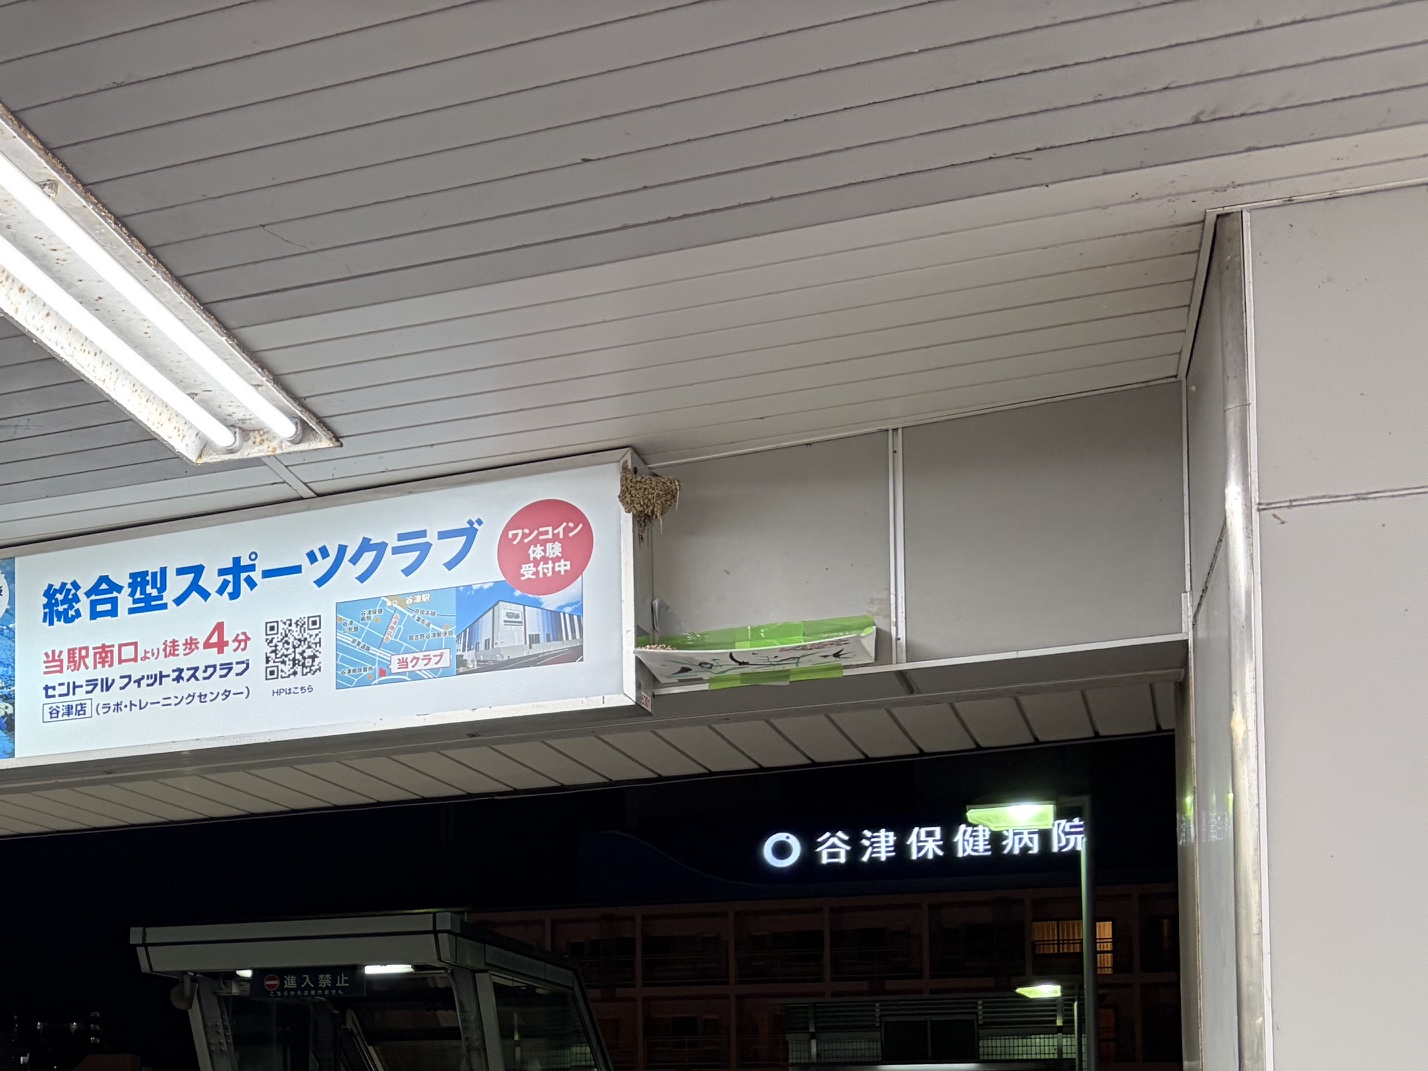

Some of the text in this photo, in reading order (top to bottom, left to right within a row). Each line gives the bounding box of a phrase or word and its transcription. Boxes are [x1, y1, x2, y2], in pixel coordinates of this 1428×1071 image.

[508, 521, 584, 545] ワンコイン
[528, 541, 563, 561] 体験
[42, 517, 484, 627] 総合型スポーツクラブ
[520, 559, 571, 581] 受付中
[43, 621, 252, 675] 当駅南口より徒歩4分
[397, 651, 445, 670] 当クラブ
[272, 684, 314, 697] HPはこちら
[48, 701, 87, 719] 谷津店
[815, 817, 1086, 866] 谷津保健病院
[283, 972, 350, 989] 進入禁止
